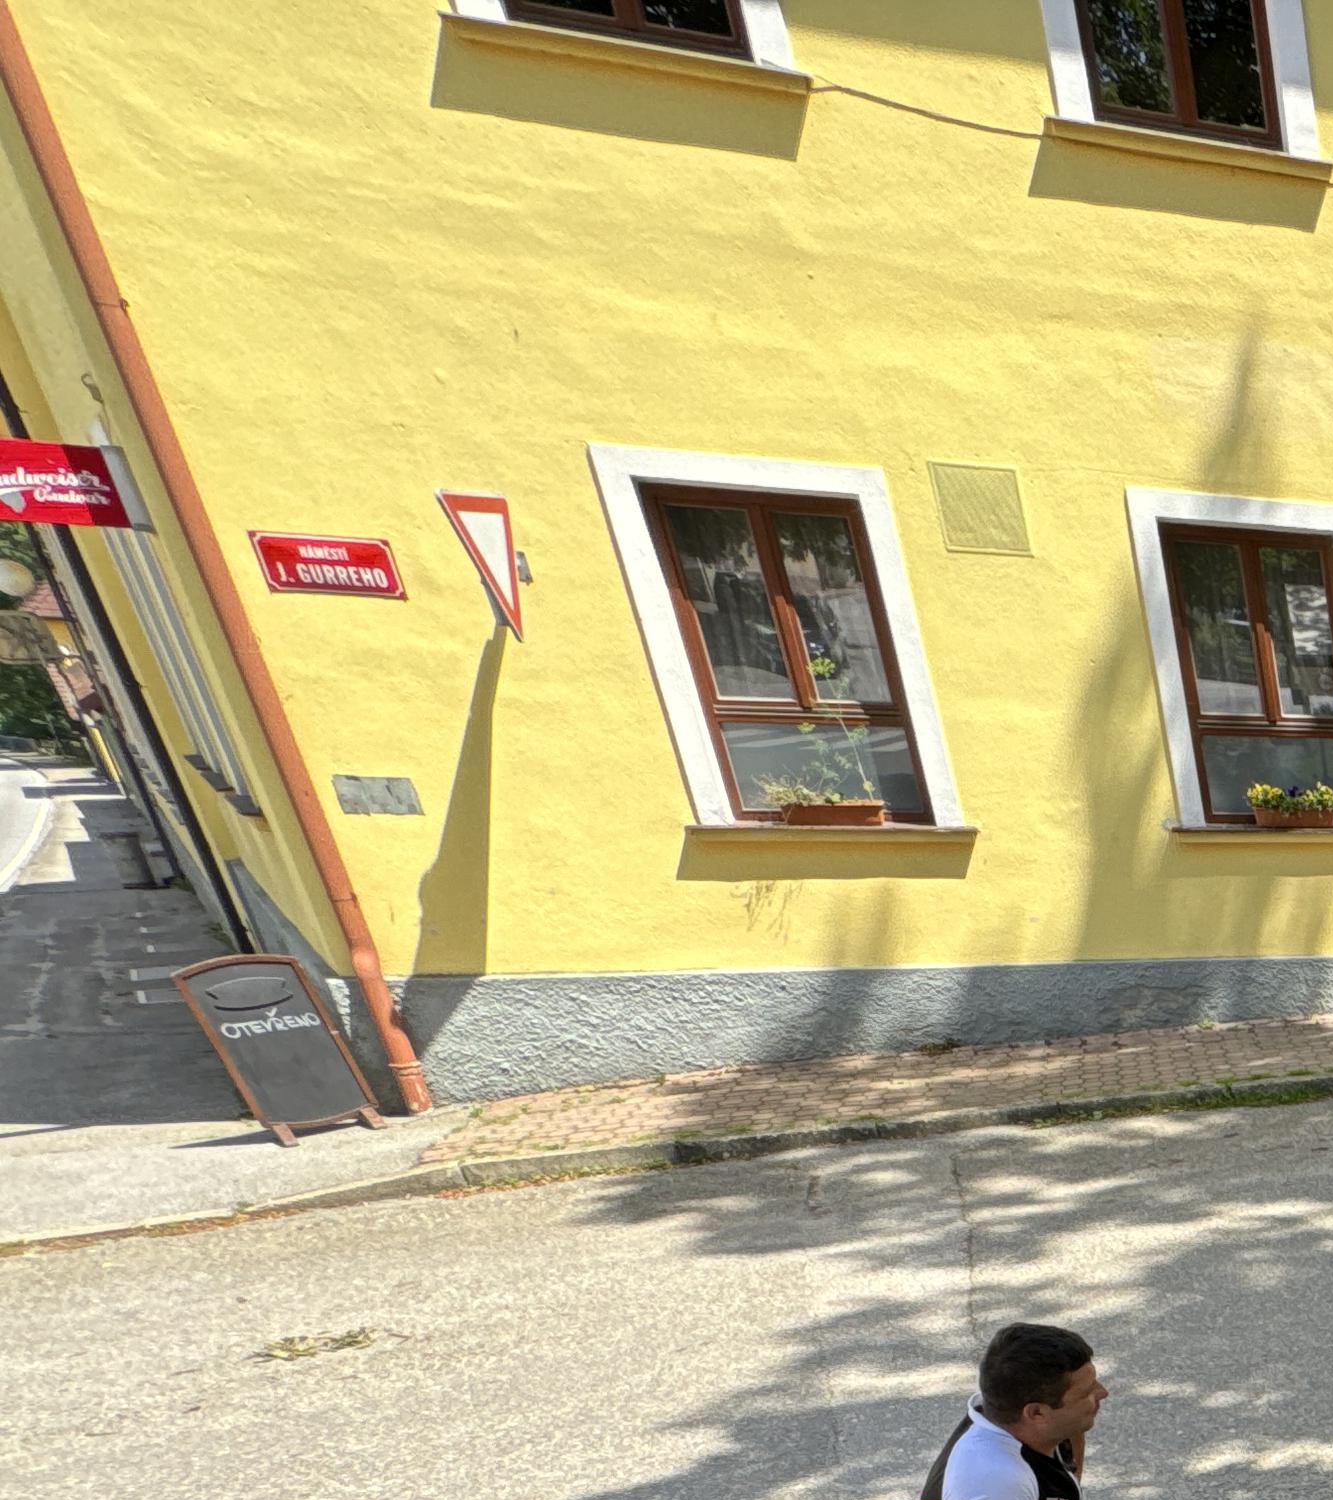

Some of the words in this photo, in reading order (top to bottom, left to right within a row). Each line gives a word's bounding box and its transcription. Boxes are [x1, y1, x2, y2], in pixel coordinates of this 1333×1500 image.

[0, 466, 110, 491] udweiser
[297, 544, 350, 562] NÁMĚSTÍ
[275, 561, 295, 582] J.
[295, 562, 389, 588] GURREHO
[220, 1007, 321, 1039] OTEVŘENO
